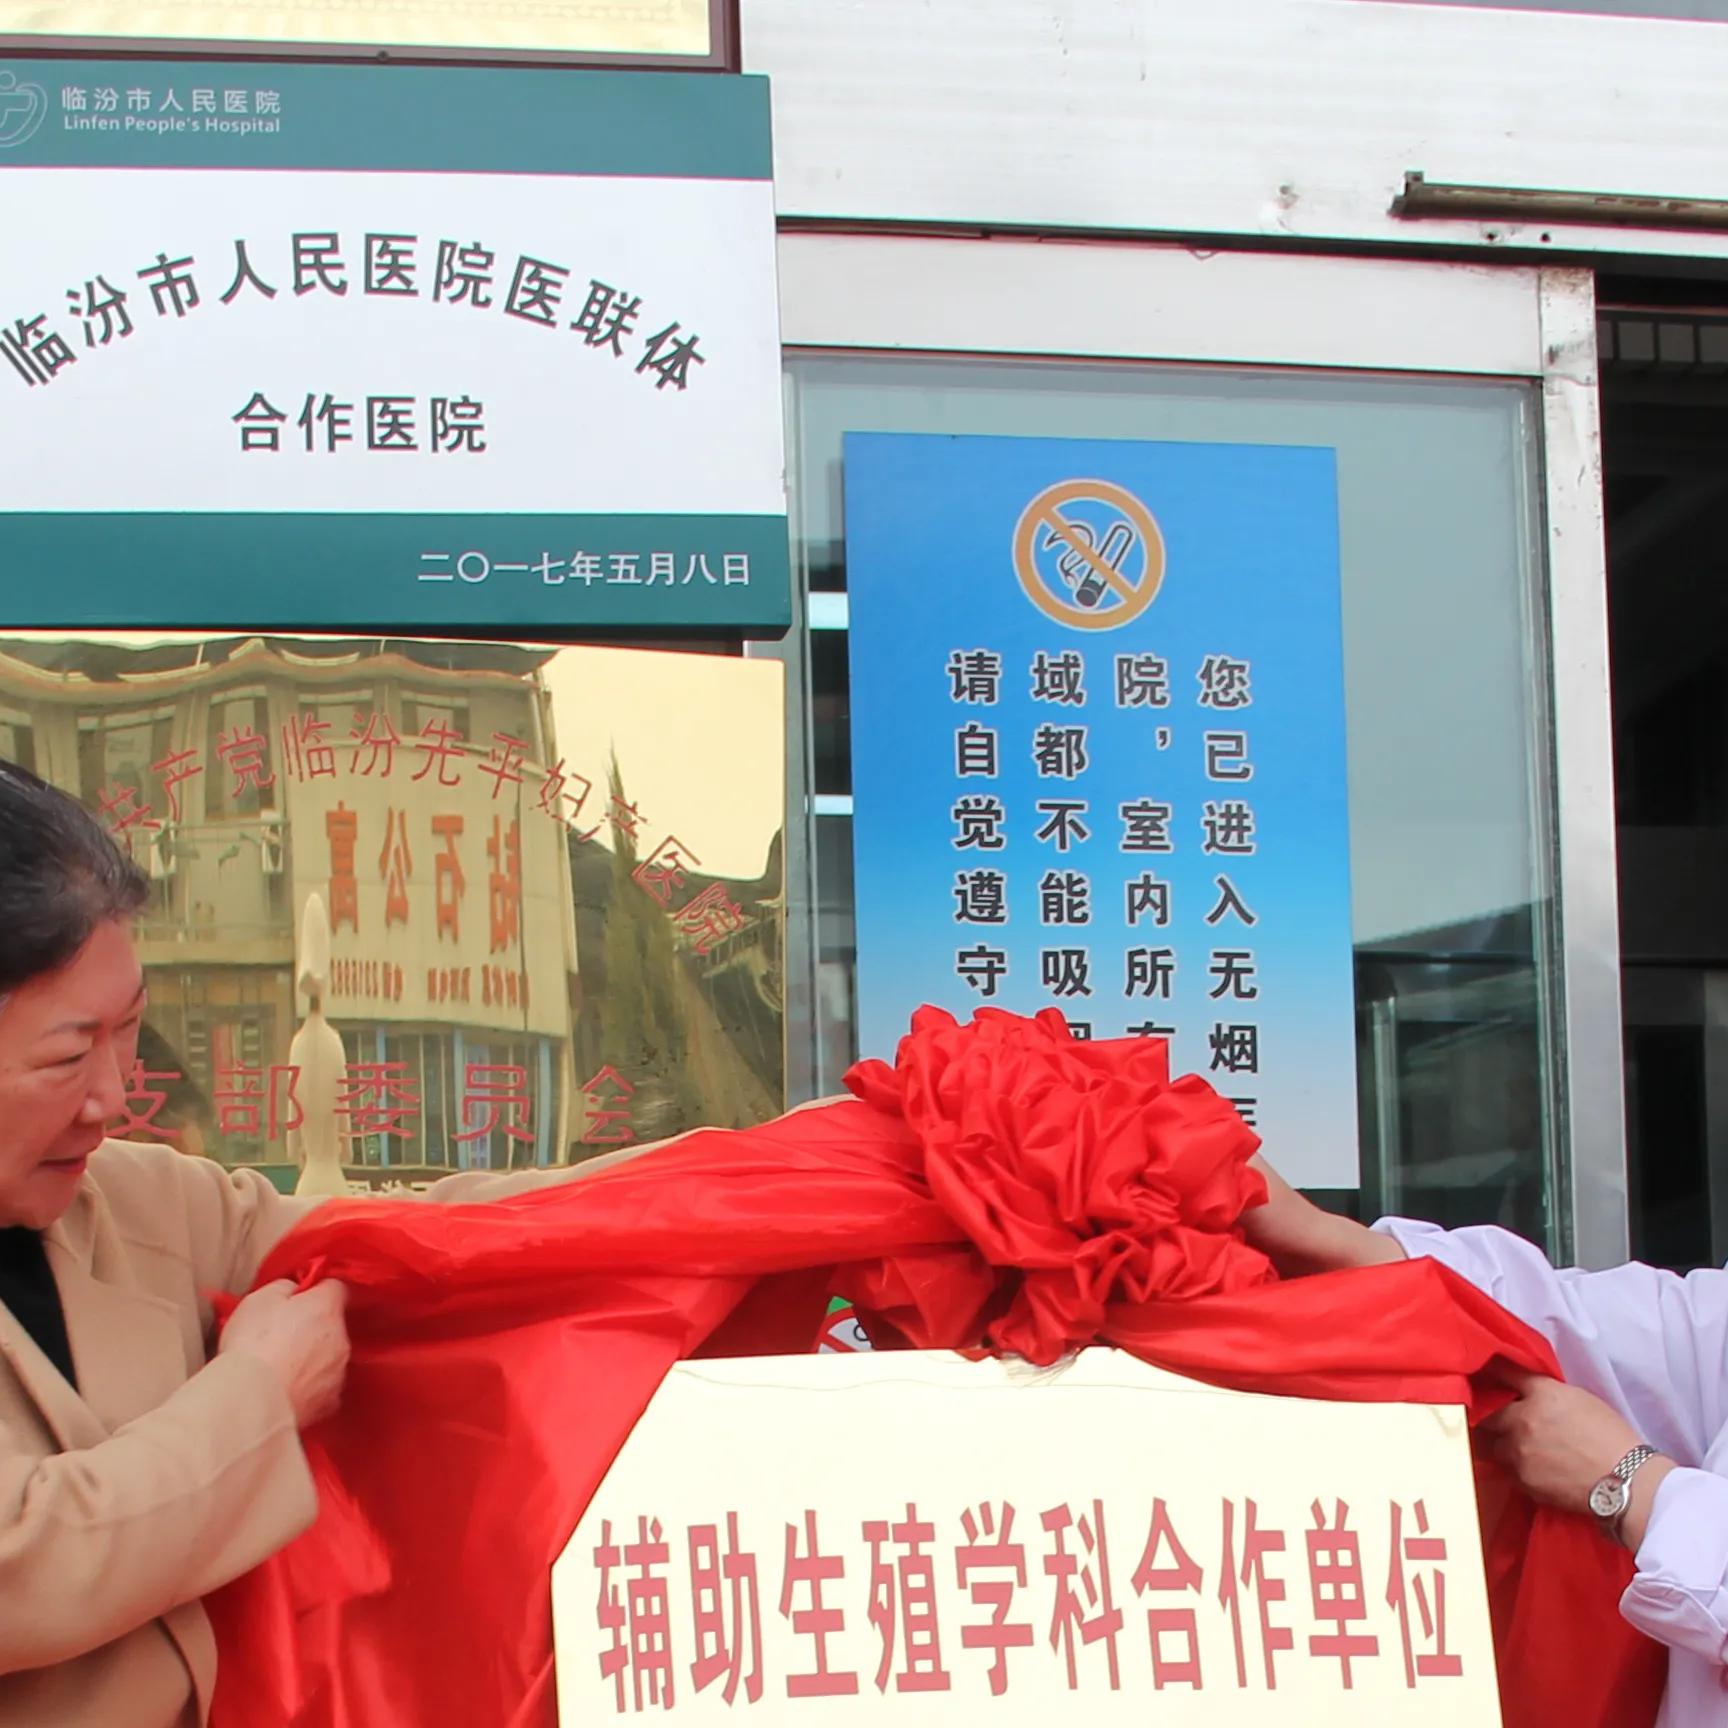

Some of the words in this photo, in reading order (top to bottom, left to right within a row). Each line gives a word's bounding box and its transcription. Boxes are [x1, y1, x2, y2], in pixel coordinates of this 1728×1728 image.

[62, 86, 281, 115] 临汾市人民医院
[64, 115, 119, 130] Linfen
[125, 116, 200, 135] People's
[206, 117, 280, 136] Hospital
[232, 391, 488, 454] 合作医院
[948, 650, 1006, 996] 请自觉遵守
[1033, 653, 1092, 1040] 域都不能吸
[107, 1058, 635, 1143] 支部委员会
[593, 1496, 1463, 1713] 辅助生殖学科合作单位
